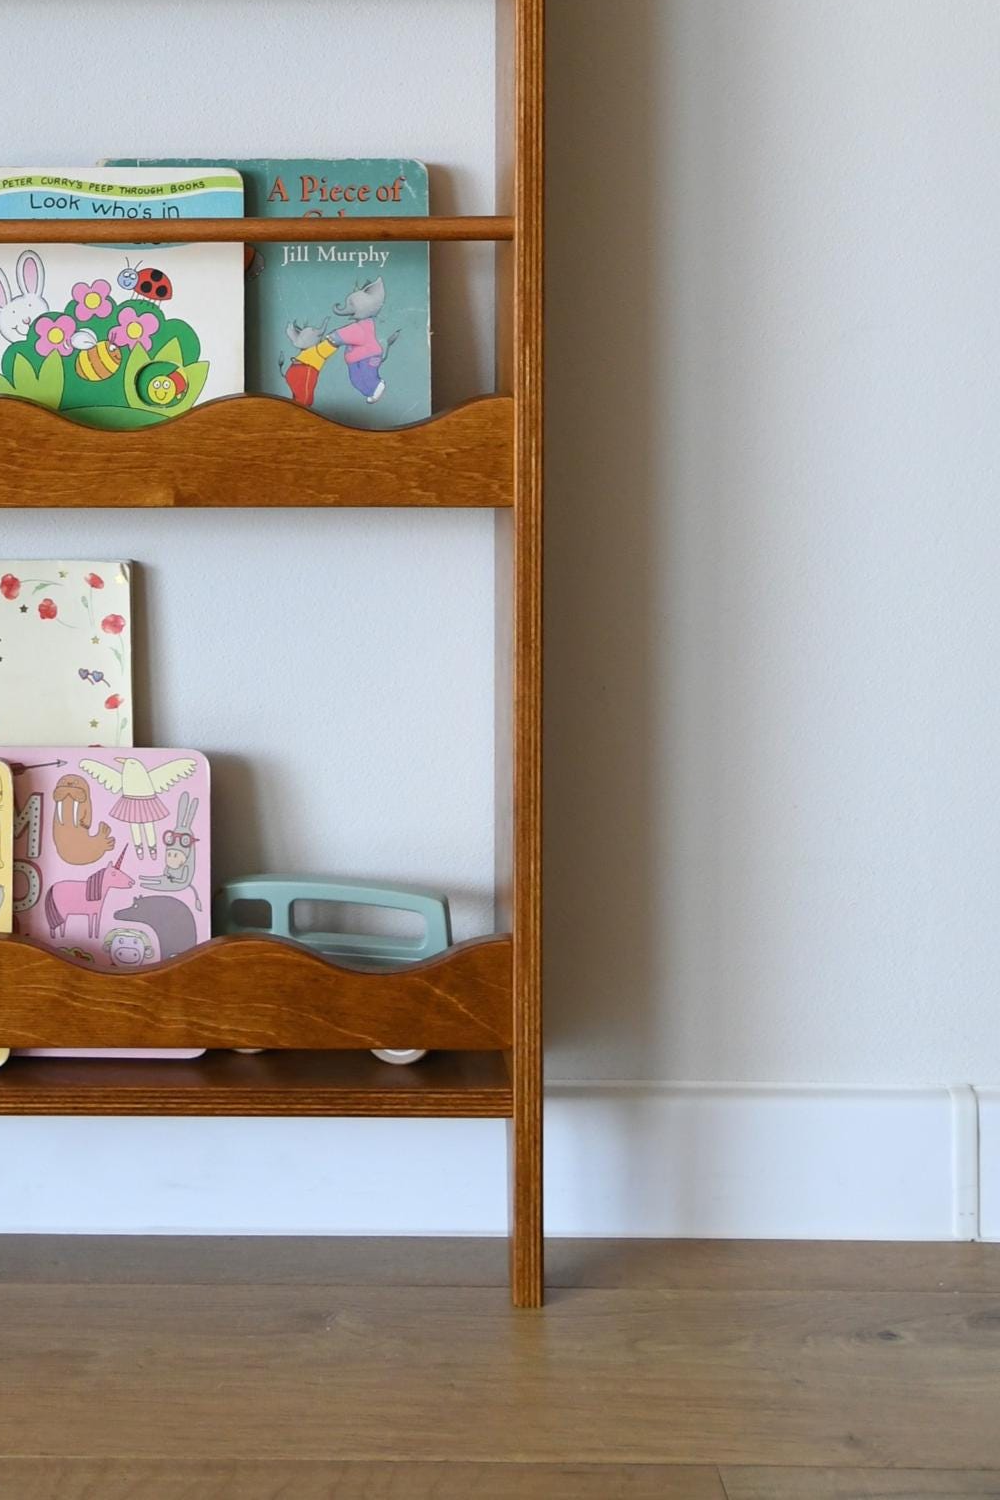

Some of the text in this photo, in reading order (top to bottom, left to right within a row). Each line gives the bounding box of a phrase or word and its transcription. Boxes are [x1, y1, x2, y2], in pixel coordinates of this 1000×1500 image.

[2, 176, 206, 195] PETER CURRY'S PEEP THROUGH BOOKS
[267, 174, 407, 203] A Piece of
[30, 193, 181, 219] Look who's in
[281, 244, 390, 268] Jill Murphy
